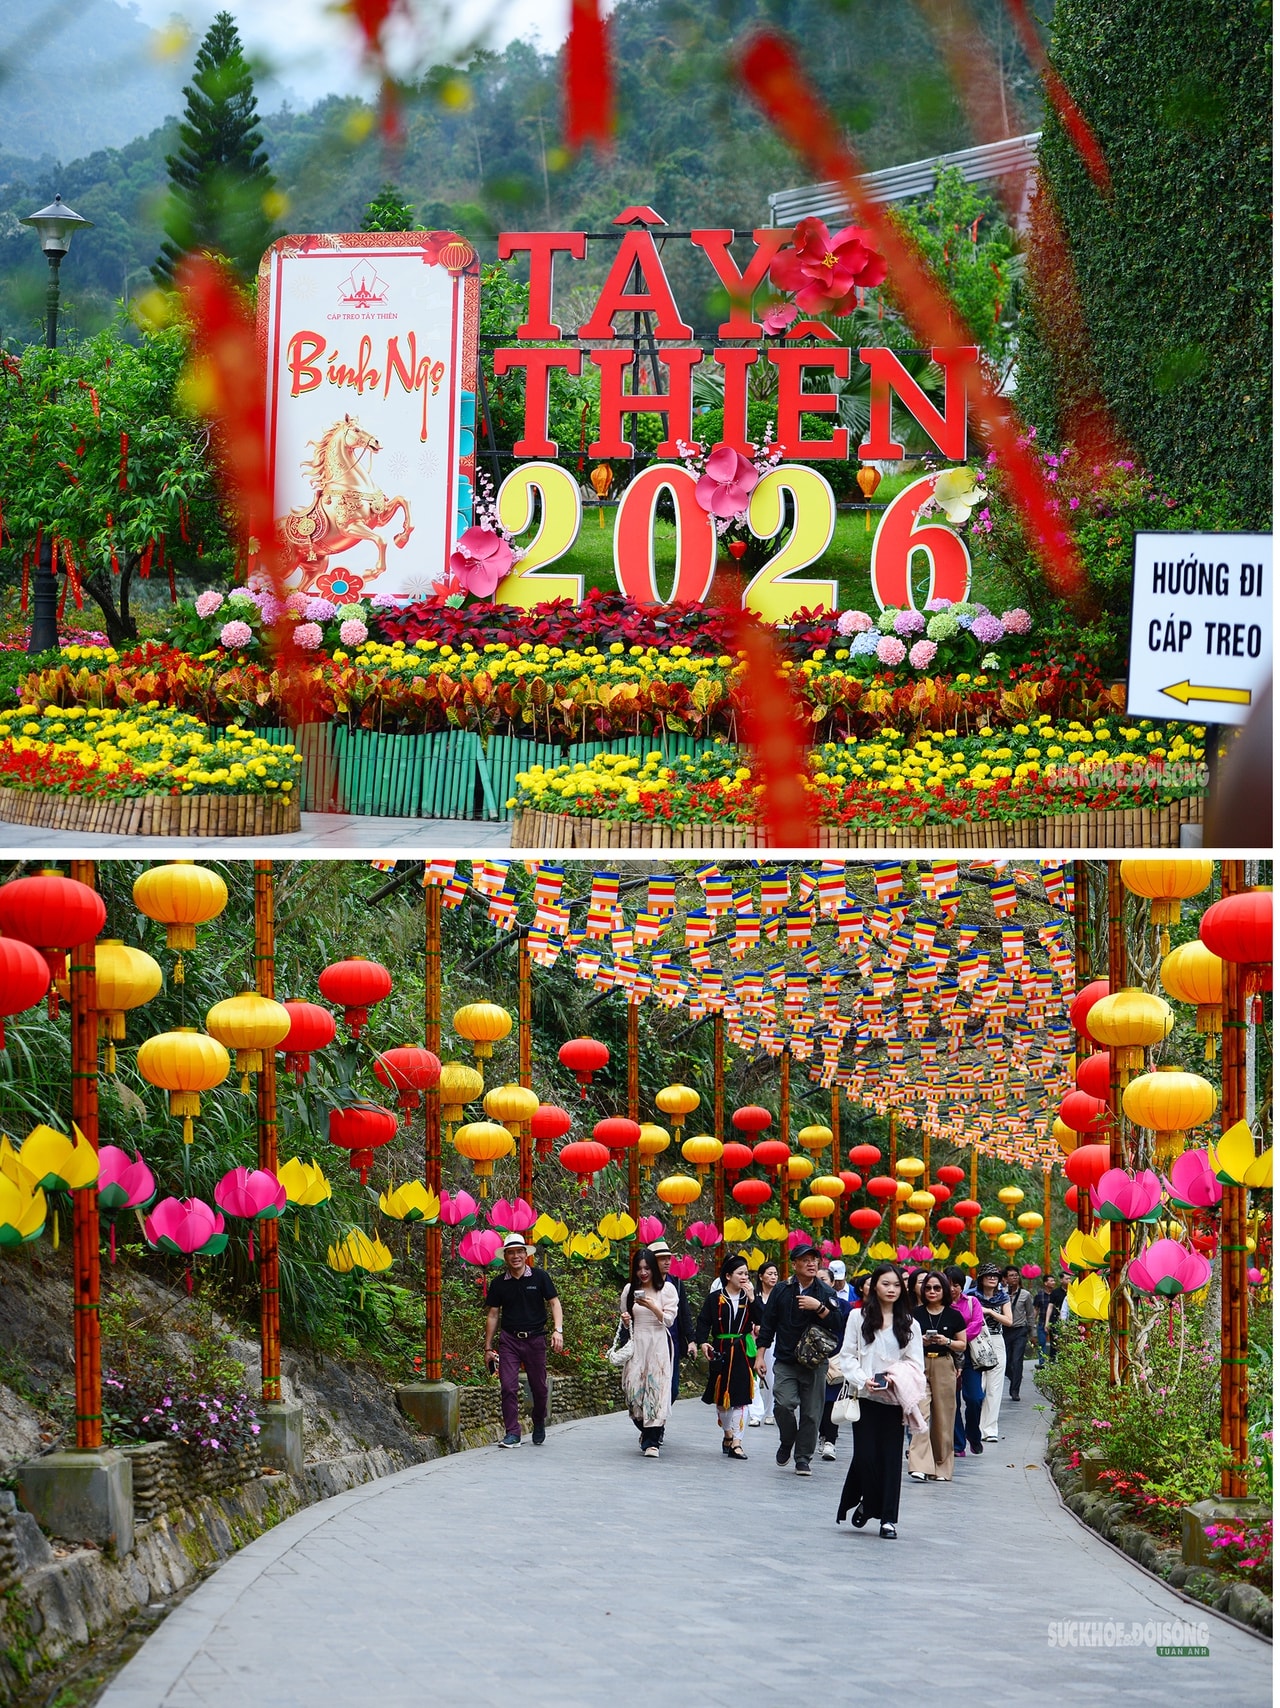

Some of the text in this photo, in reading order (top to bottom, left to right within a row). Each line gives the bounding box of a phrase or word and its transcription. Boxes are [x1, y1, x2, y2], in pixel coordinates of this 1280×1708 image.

[498, 206, 798, 341] TÂY
[383, 330, 446, 443] Ngọ
[494, 321, 981, 462] THIÊN
[493, 462, 974, 628] 2026
[1152, 553, 1263, 597] HƯỚNG ĐI
[1148, 613, 1262, 658] CÁP TREO
